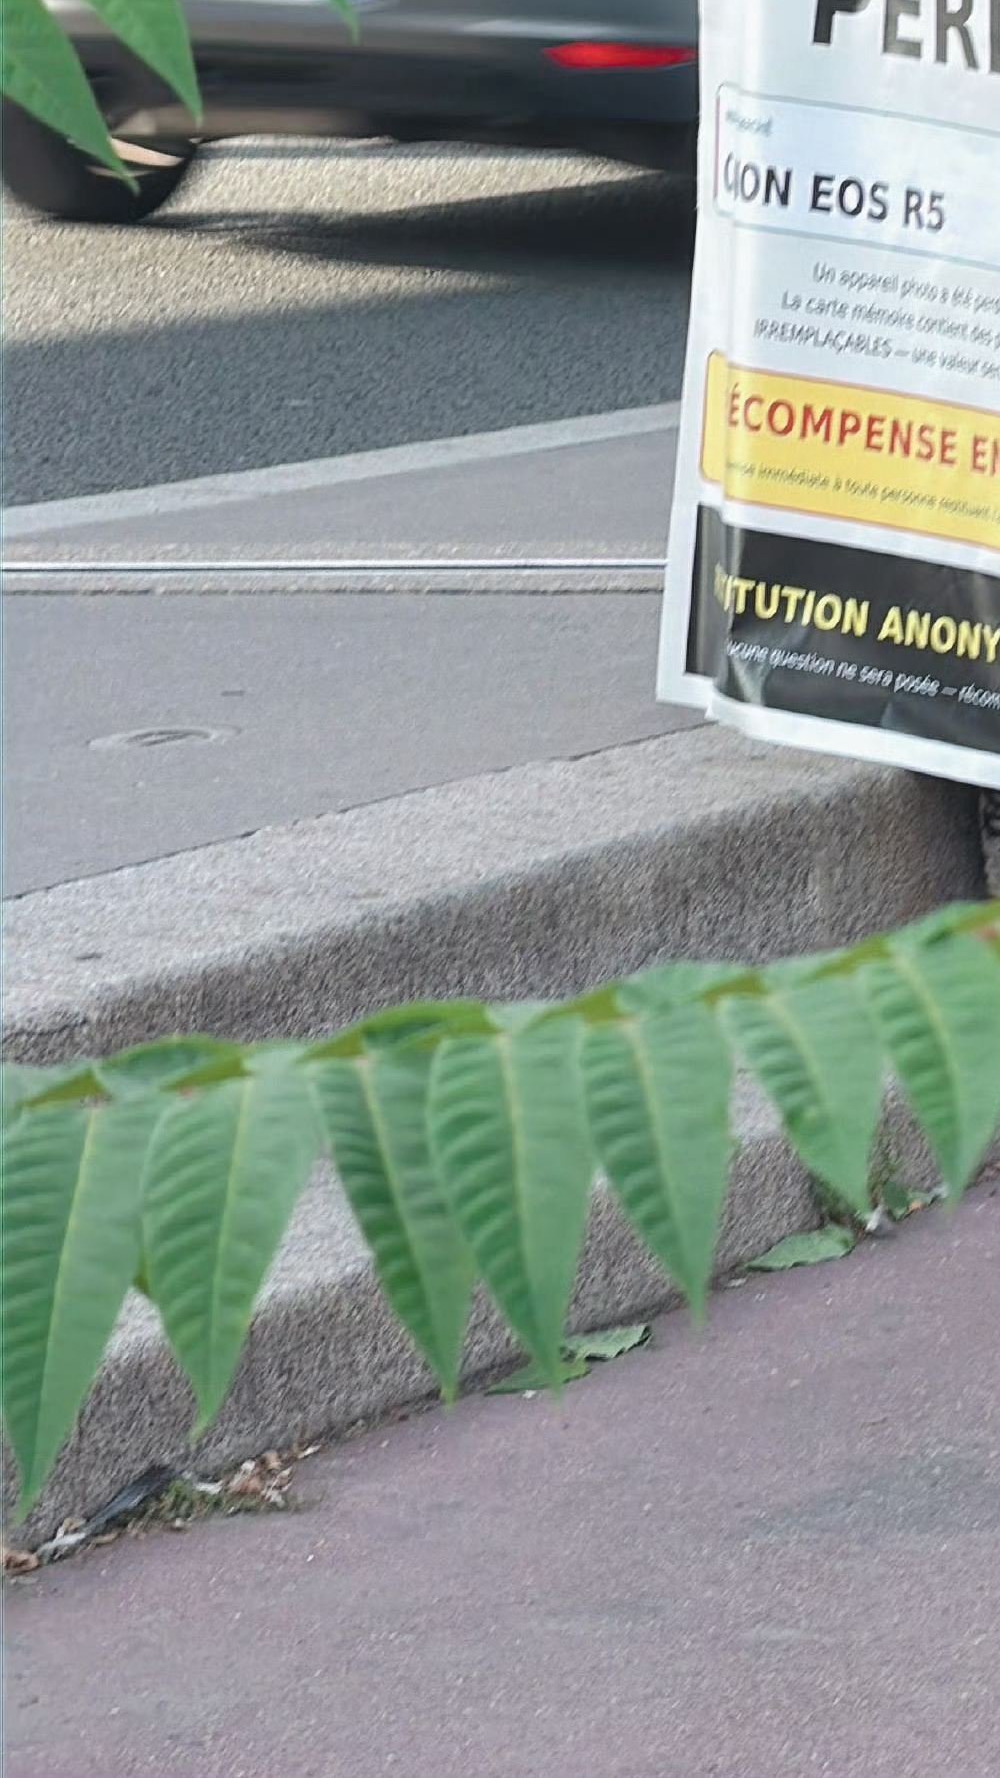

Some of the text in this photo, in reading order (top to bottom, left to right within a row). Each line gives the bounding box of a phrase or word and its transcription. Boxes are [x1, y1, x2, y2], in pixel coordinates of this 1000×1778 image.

[809, 172, 889, 221] EOS
[903, 185, 946, 233] R5
[813, 261, 836, 284] Un
[839, 269, 899, 293] appareil
[781, 288, 802, 311] La
[805, 296, 849, 319] carte
[851, 302, 915, 330] mémoire
[753, 317, 893, 359] IRREMPLAÇABLES
[728, 382, 956, 466] ÉCOMPENSE
[726, 639, 769, 664] ucune
[770, 649, 836, 678] question
[836, 660, 857, 681] ne
[859, 665, 893, 687] sera
[893, 673, 940, 697] posée
